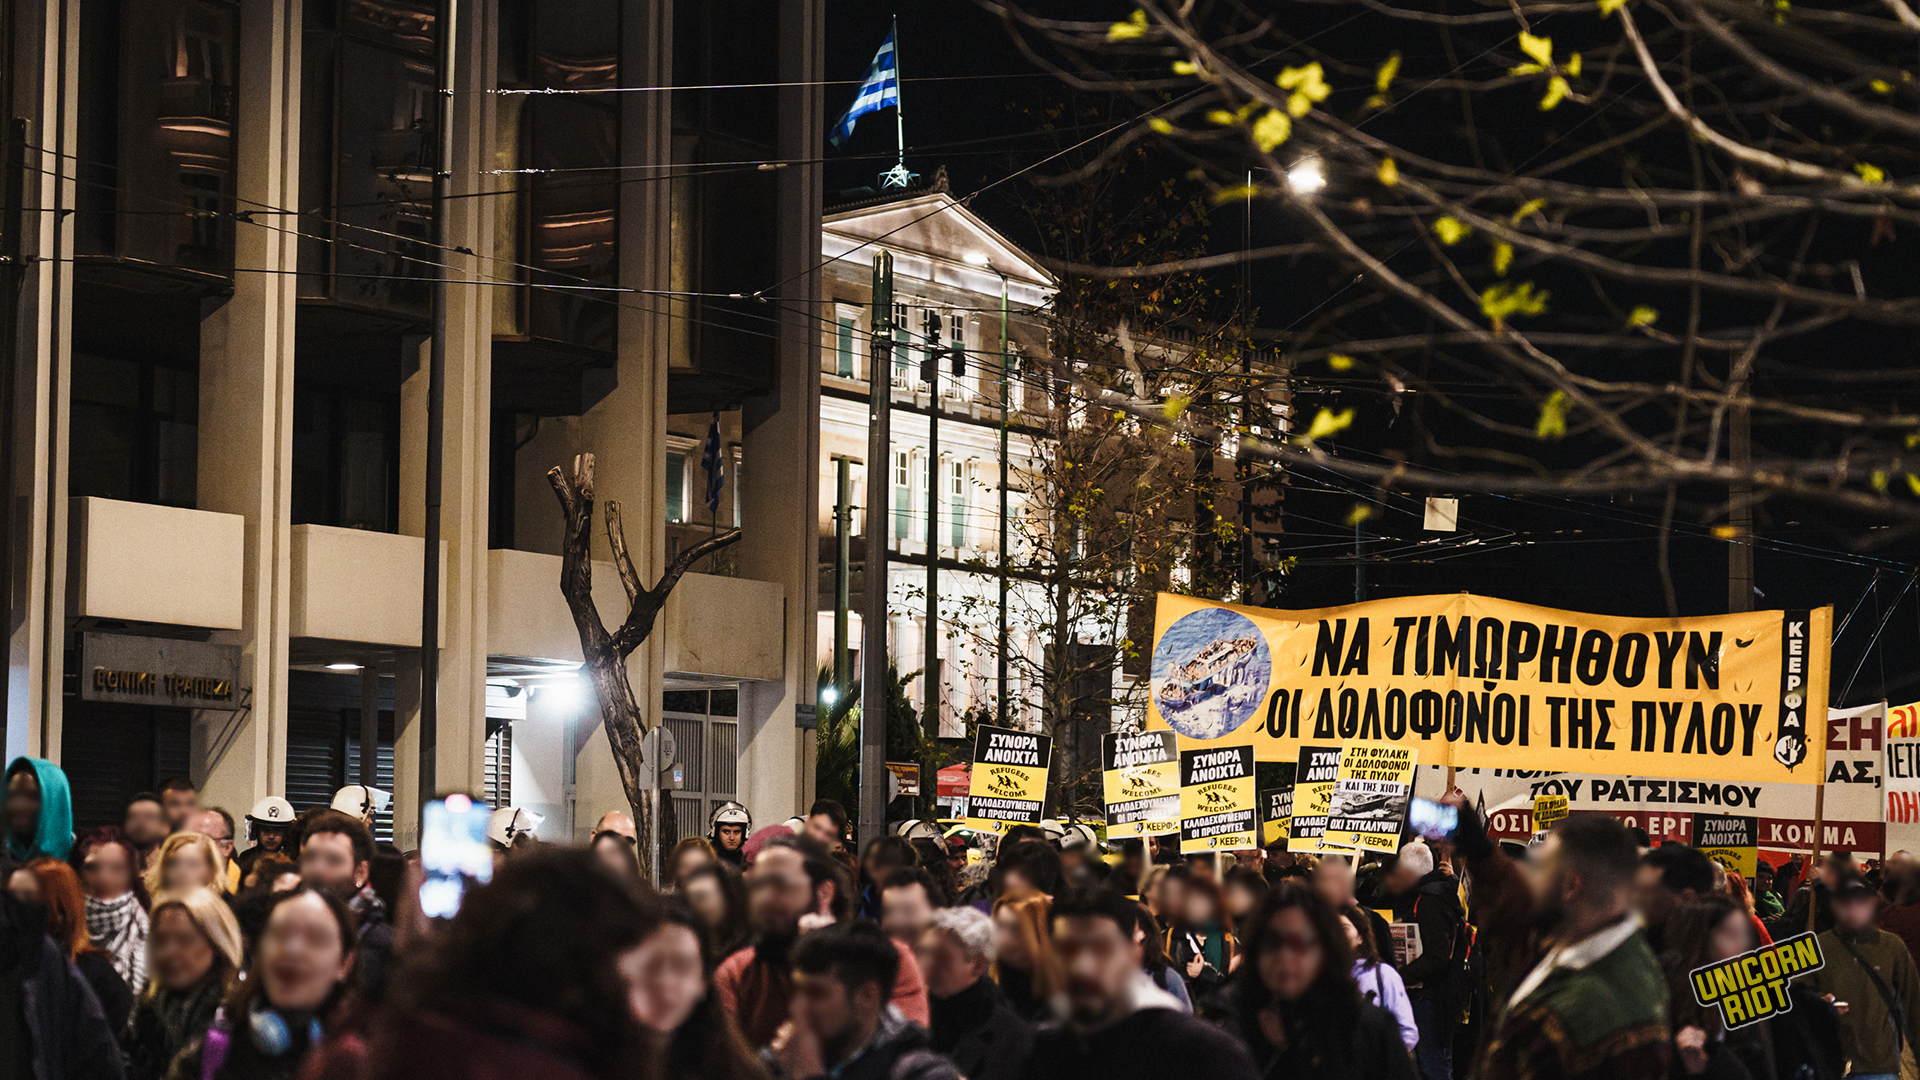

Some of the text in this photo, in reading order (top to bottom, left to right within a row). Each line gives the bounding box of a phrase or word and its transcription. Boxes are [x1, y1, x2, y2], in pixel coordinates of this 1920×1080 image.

[1311, 615, 1723, 690] ΝΑ ΤΙΜΩΡΗΘΟΥΝ
[1784, 621, 1803, 727] ΚΕΕΡΦΑ
[96, 669, 233, 697] ΕΘΝΙΚΗ ΤΡΑΠΕΖΑ
[1266, 688, 1762, 756] ΟΙ ΔΟΛΟΦΟΝΟΙ ΤΗΣ ΠΥΛΟΥ
[1827, 717, 1882, 751] ΣΗ
[989, 733, 1038, 750] ΣΥΝΟΡΑ
[1115, 733, 1164, 752] ΣΥΝΟΡΑ
[984, 748, 1039, 765] ΑΝΟΙΧΤΑ
[1113, 748, 1168, 767] ΑΝΟΙΧΤΑ
[1193, 749, 1241, 769] ΣΥΝΟΡΑ
[1310, 752, 1342, 766] ΣΥΝΟ
[1350, 747, 1409, 760] ΣΤΗ ΦΥΛΑΚΗ
[1344, 758, 1410, 771] ΟΙ ΔΟΛΟΦΟΝΟΙ
[990, 767, 1030, 781] REFUGEES
[1190, 763, 1244, 784] ΑΝΟΙΧΤΑ
[1306, 766, 1338, 781] ΑΝΟΙ
[1351, 770, 1400, 781] ΤΗΣ ΠΥΛΟΥ
[1827, 760, 1881, 788] ΑΣ,
[987, 783, 1028, 797] WELCOME
[1121, 787, 1163, 798] WELCOME
[1197, 783, 1238, 796] REFUGEES
[1312, 784, 1335, 795] REFU
[1345, 781, 1400, 793] ΚΑΙ ΤΗΣ ΧΙΟΥ
[1530, 779, 1762, 808] ΤΟΥ ΡΑΤΣΙΣΜΟΥ
[971, 797, 1040, 812] ΚΑΛΟΔΕΧΟΥΜΕΝΟΙ
[1271, 791, 1295, 806] ΣΥΝΟ
[1197, 801, 1238, 813] WELCOME
[1310, 803, 1330, 813] WELC
[978, 808, 1031, 821] ΟΙ ΠΡΟΣΦΥΓΕΣ
[1117, 813, 1126, 824] ΟΙ
[1183, 810, 1252, 829] ΚΑΛΟΔΕΧΟΥΜΕΝΟΙ
[1191, 821, 1245, 839] ΟΙ ΠΡΟΣΦΥΓΕΣ
[1300, 828, 1309, 837] ΟΙ
[1330, 818, 1398, 833] ΟΧΙ ΣΥΓΚΑΛΥΨΗ!
[1493, 813, 1529, 832] ΟΣΙ
[1770, 823, 1857, 846] ΚΟΜΜΑ
[1704, 819, 1747, 832] ΣΥΝΟΡΑ
[1220, 836, 1252, 846] ΚΕΕΡΦΑ
[1362, 836, 1393, 848] ΚΕΕΡΦΑ
[1701, 832, 1749, 845] ΑΝΟΙΧΤΑ
[1706, 849, 1742, 861] REFUGEES
